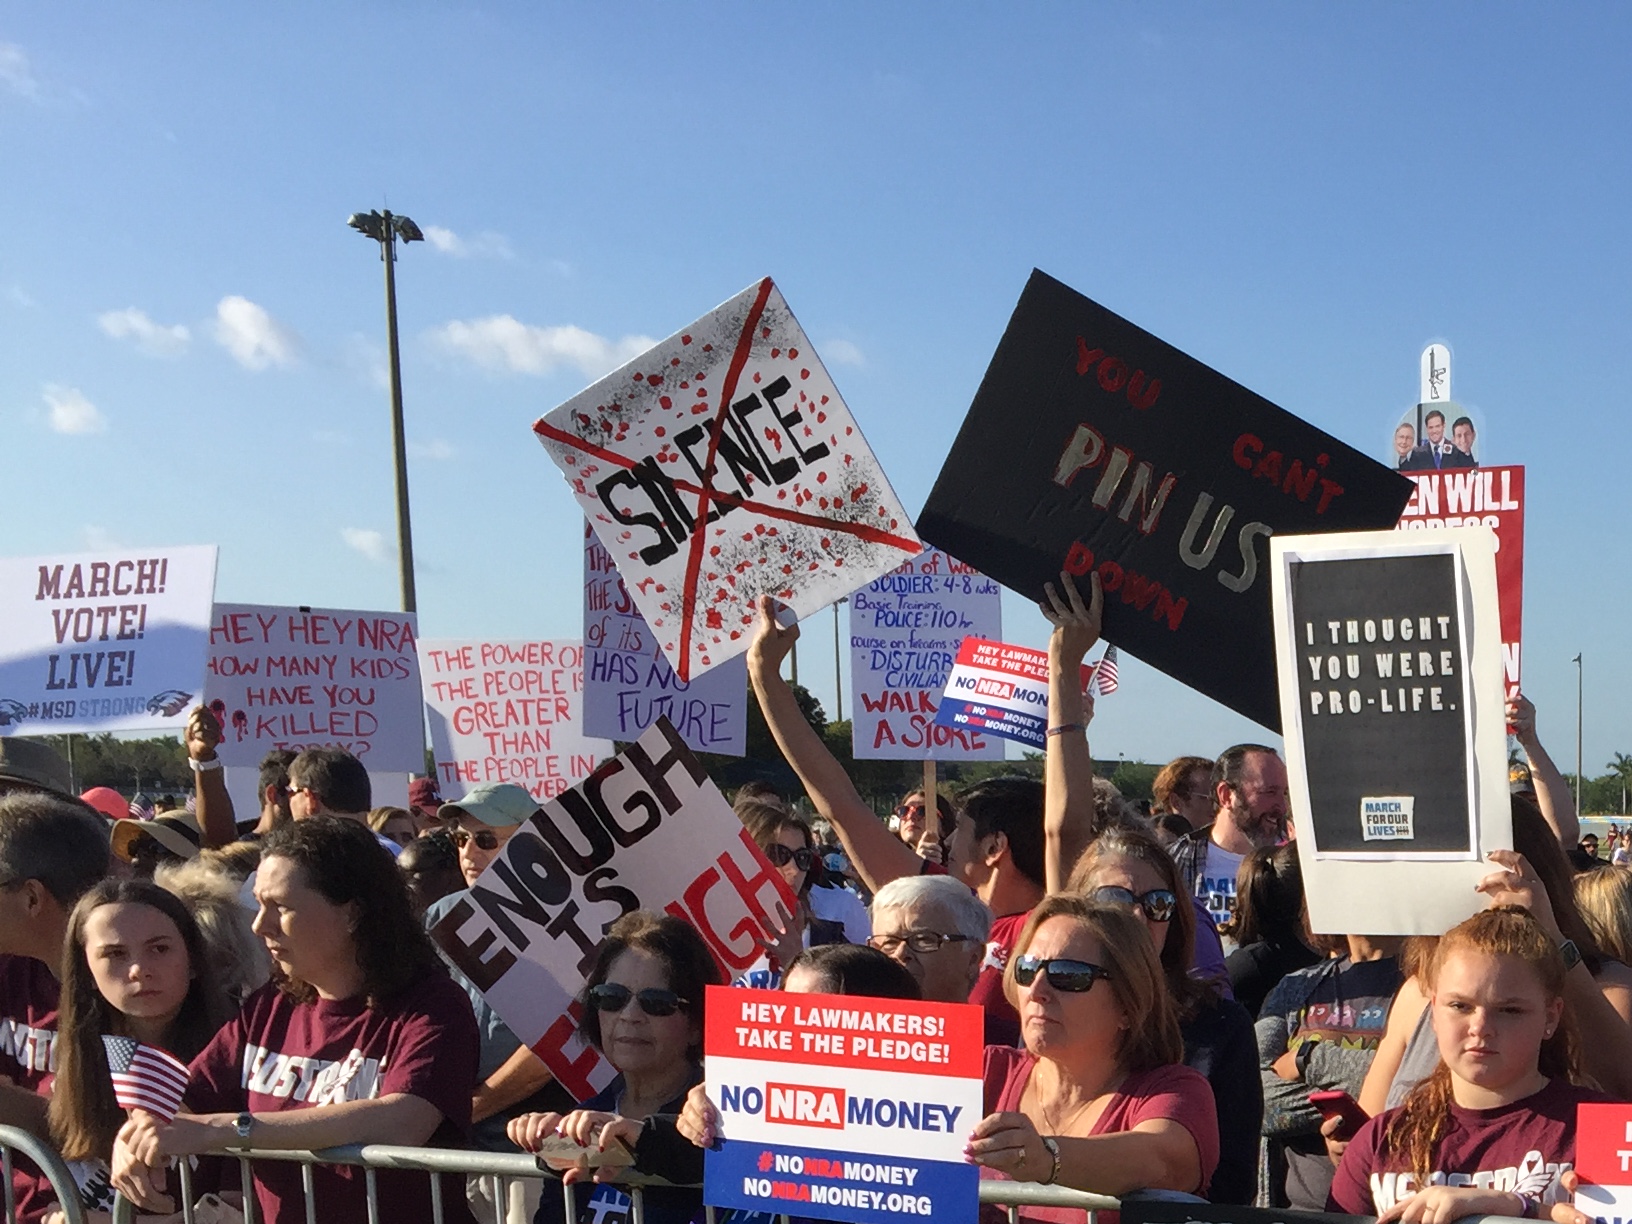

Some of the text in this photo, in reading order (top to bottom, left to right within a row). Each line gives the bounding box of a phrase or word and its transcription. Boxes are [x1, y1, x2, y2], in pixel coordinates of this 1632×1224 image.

[1075, 336, 1162, 410] YOU
[596, 375, 830, 566] SILENCE
[1233, 431, 1345, 515] CAN'T
[1053, 422, 1273, 594] PIN US
[1445, 470, 1519, 514] WILL
[35, 558, 168, 600] MARCH!
[943, 575, 972, 594] 4-8
[1062, 540, 1189, 633] DOWN
[854, 593, 892, 611] Basic
[52, 604, 147, 644] VOTE!
[210, 613, 418, 653] HEY HEY NRA
[588, 615, 643, 652] of its
[875, 611, 929, 628] POLICE:
[931, 611, 957, 628] 110
[1306, 616, 1451, 646] I THOUGHT
[428, 642, 554, 672] THE POWER
[851, 636, 887, 649] course
[890, 639, 906, 649] on
[977, 644, 1000, 658] HEY
[45, 650, 135, 690] LIVE!
[266, 654, 338, 680] MANY
[351, 657, 411, 680] KIDS
[591, 651, 640, 684] HAS
[972, 654, 1021, 672] TAKE THE
[1308, 651, 1455, 682] YOU WERE
[246, 684, 375, 708] HAVE YOU
[431, 670, 567, 702] THE PEOPLE
[861, 690, 938, 713] WALK
[955, 676, 1011, 698] NO NRA
[1310, 686, 1458, 716] PRO-LIFE.
[256, 710, 378, 739] KILLED
[453, 697, 571, 736] GREATER
[617, 690, 733, 747] FUTURE
[483, 729, 551, 755] THAN
[873, 719, 897, 749] A
[438, 754, 594, 782] THE PEOPLE IN
[1365, 802, 1402, 813] MARCH
[1367, 825, 1396, 836] LIVES
[429, 713, 708, 993] ENOUGH
[741, 1002, 946, 1038] HEY LAWMAKERS!
[735, 1027, 950, 1064] TAKE THE PLEDGE!
[720, 1084, 964, 1134] NO NRA MONEY
[757, 1150, 919, 1187] #NONRAMONEY
[743, 1177, 933, 1216] NONRAMONEY.ORG
